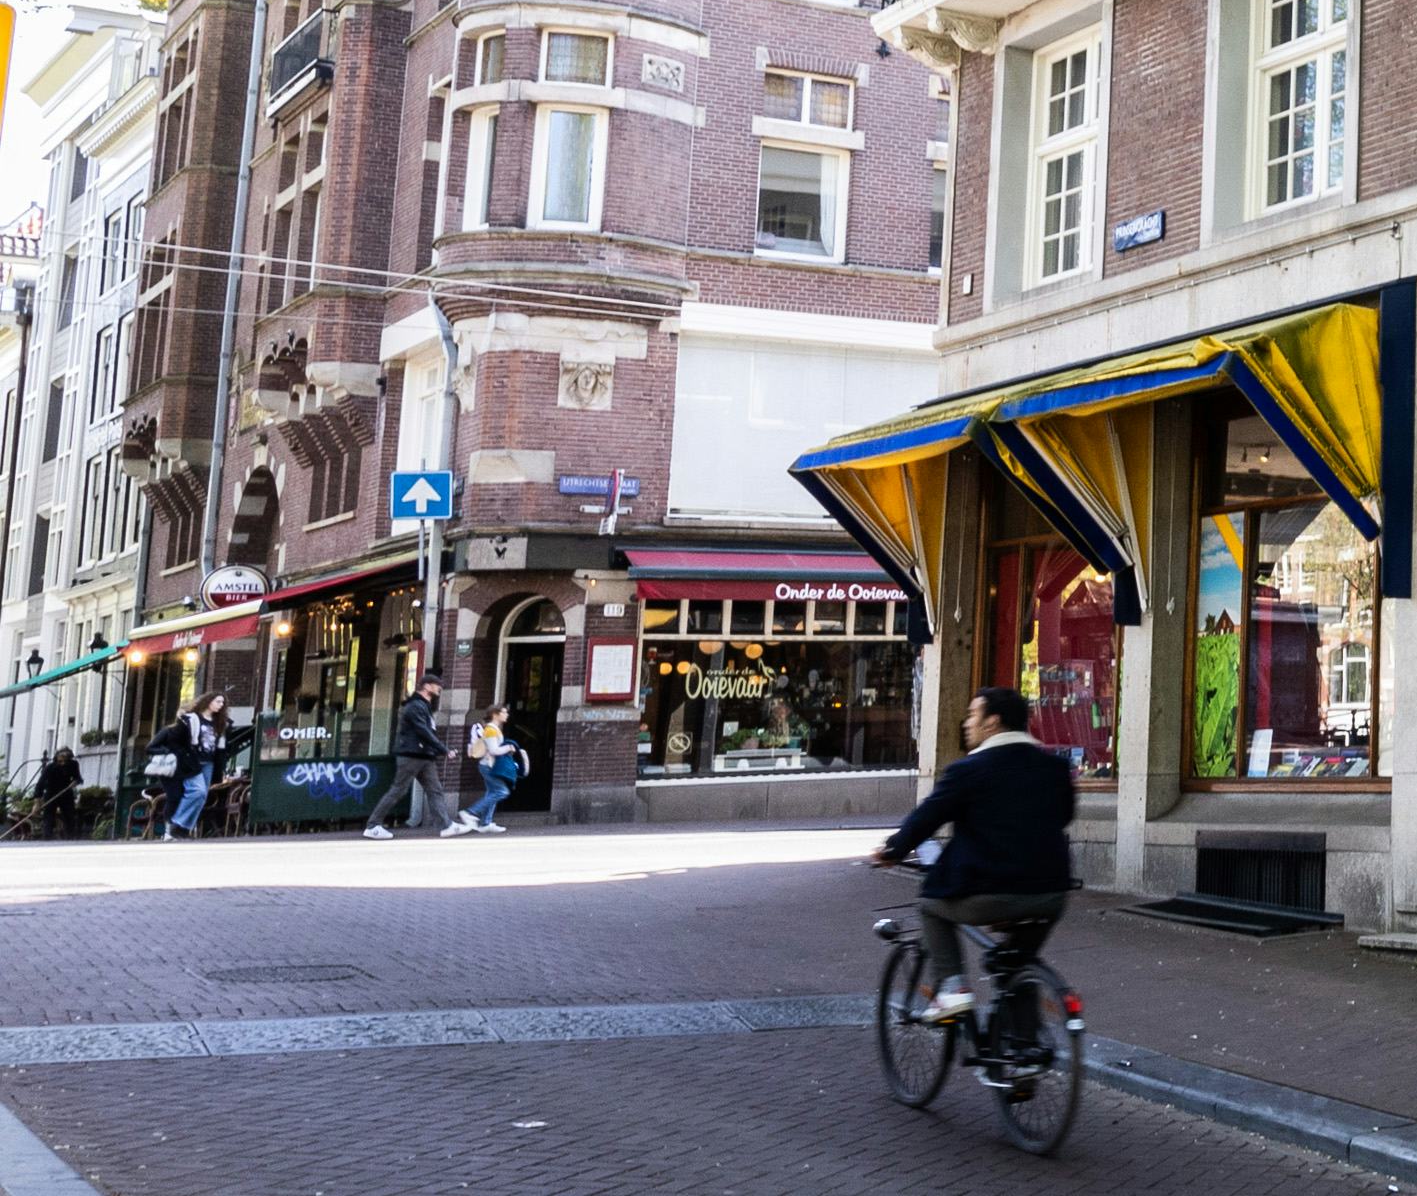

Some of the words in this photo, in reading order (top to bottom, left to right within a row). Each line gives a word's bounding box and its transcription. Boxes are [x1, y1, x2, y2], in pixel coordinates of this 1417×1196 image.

[563, 477, 636, 488] UTRECHTSEAAT
[214, 583, 260, 592] AMSTEL
[775, 583, 825, 600] Onder
[826, 583, 846, 600] de
[848, 583, 909, 600] Ooieva
[225, 594, 248, 602] BIER
[685, 662, 768, 700] Ooievaar
